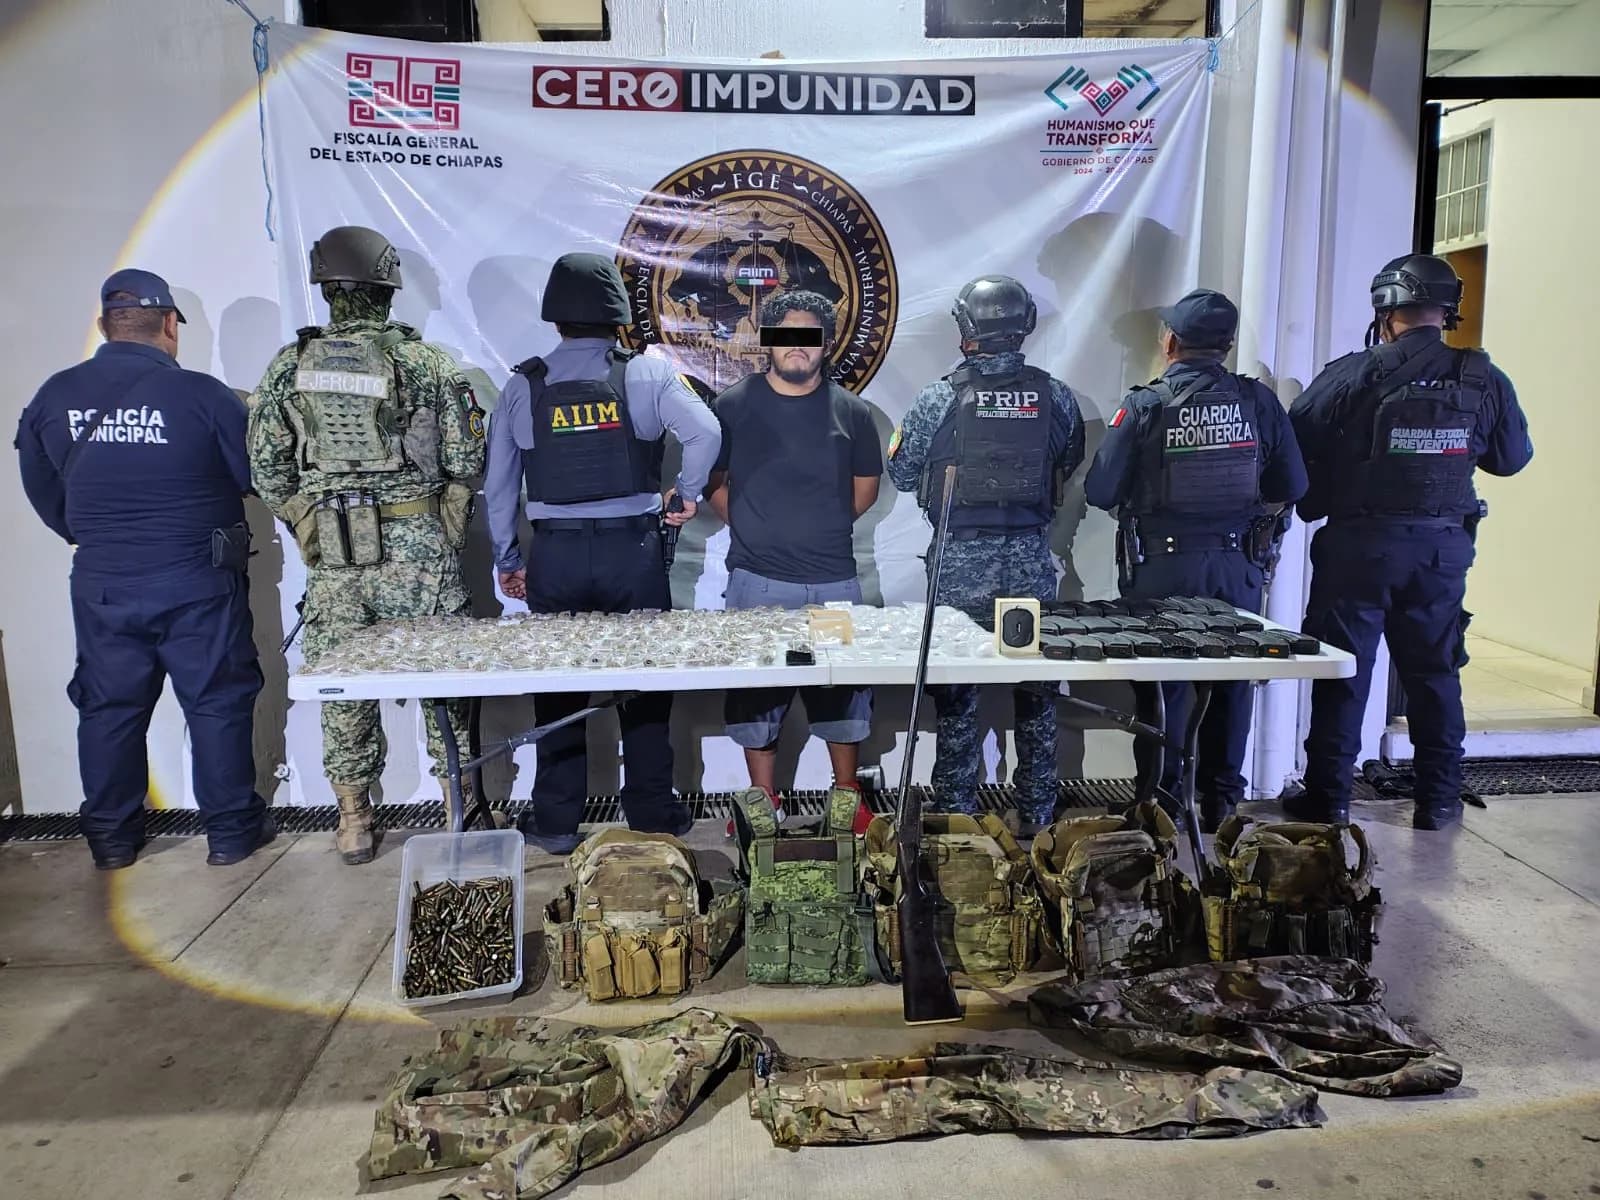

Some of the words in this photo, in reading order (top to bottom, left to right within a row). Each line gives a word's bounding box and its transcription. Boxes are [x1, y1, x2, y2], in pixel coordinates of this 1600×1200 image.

[690, 72, 973, 111] IMPUNIDAD
[1047, 120, 1125, 131] HUMANISMO
[1128, 119, 1156, 131] QUE
[333, 132, 402, 148] FISCALÍA
[406, 135, 479, 150] GENERAL
[1046, 131, 1153, 146] TRANSFORMA
[310, 147, 341, 161] DEL
[346, 151, 406, 164] ESTADO
[410, 154, 431, 166] DE
[435, 154, 503, 168] CHIAPAS
[1042, 157, 1095, 166] GOBIERNO
[1097, 156, 1112, 165] DE
[732, 172, 781, 191] FGE
[811, 191, 855, 235] CHIAPAS
[854, 246, 875, 349] MINISTERIAL
[976, 391, 1039, 407] FRIP
[551, 401, 619, 428] AIIM
[1178, 403, 1242, 427] GUARDIA
[1166, 421, 1253, 448] FRONTERIZA
[1391, 428, 1433, 439] GUARDIA
[1390, 438, 1468, 449] PREVENTIVA
